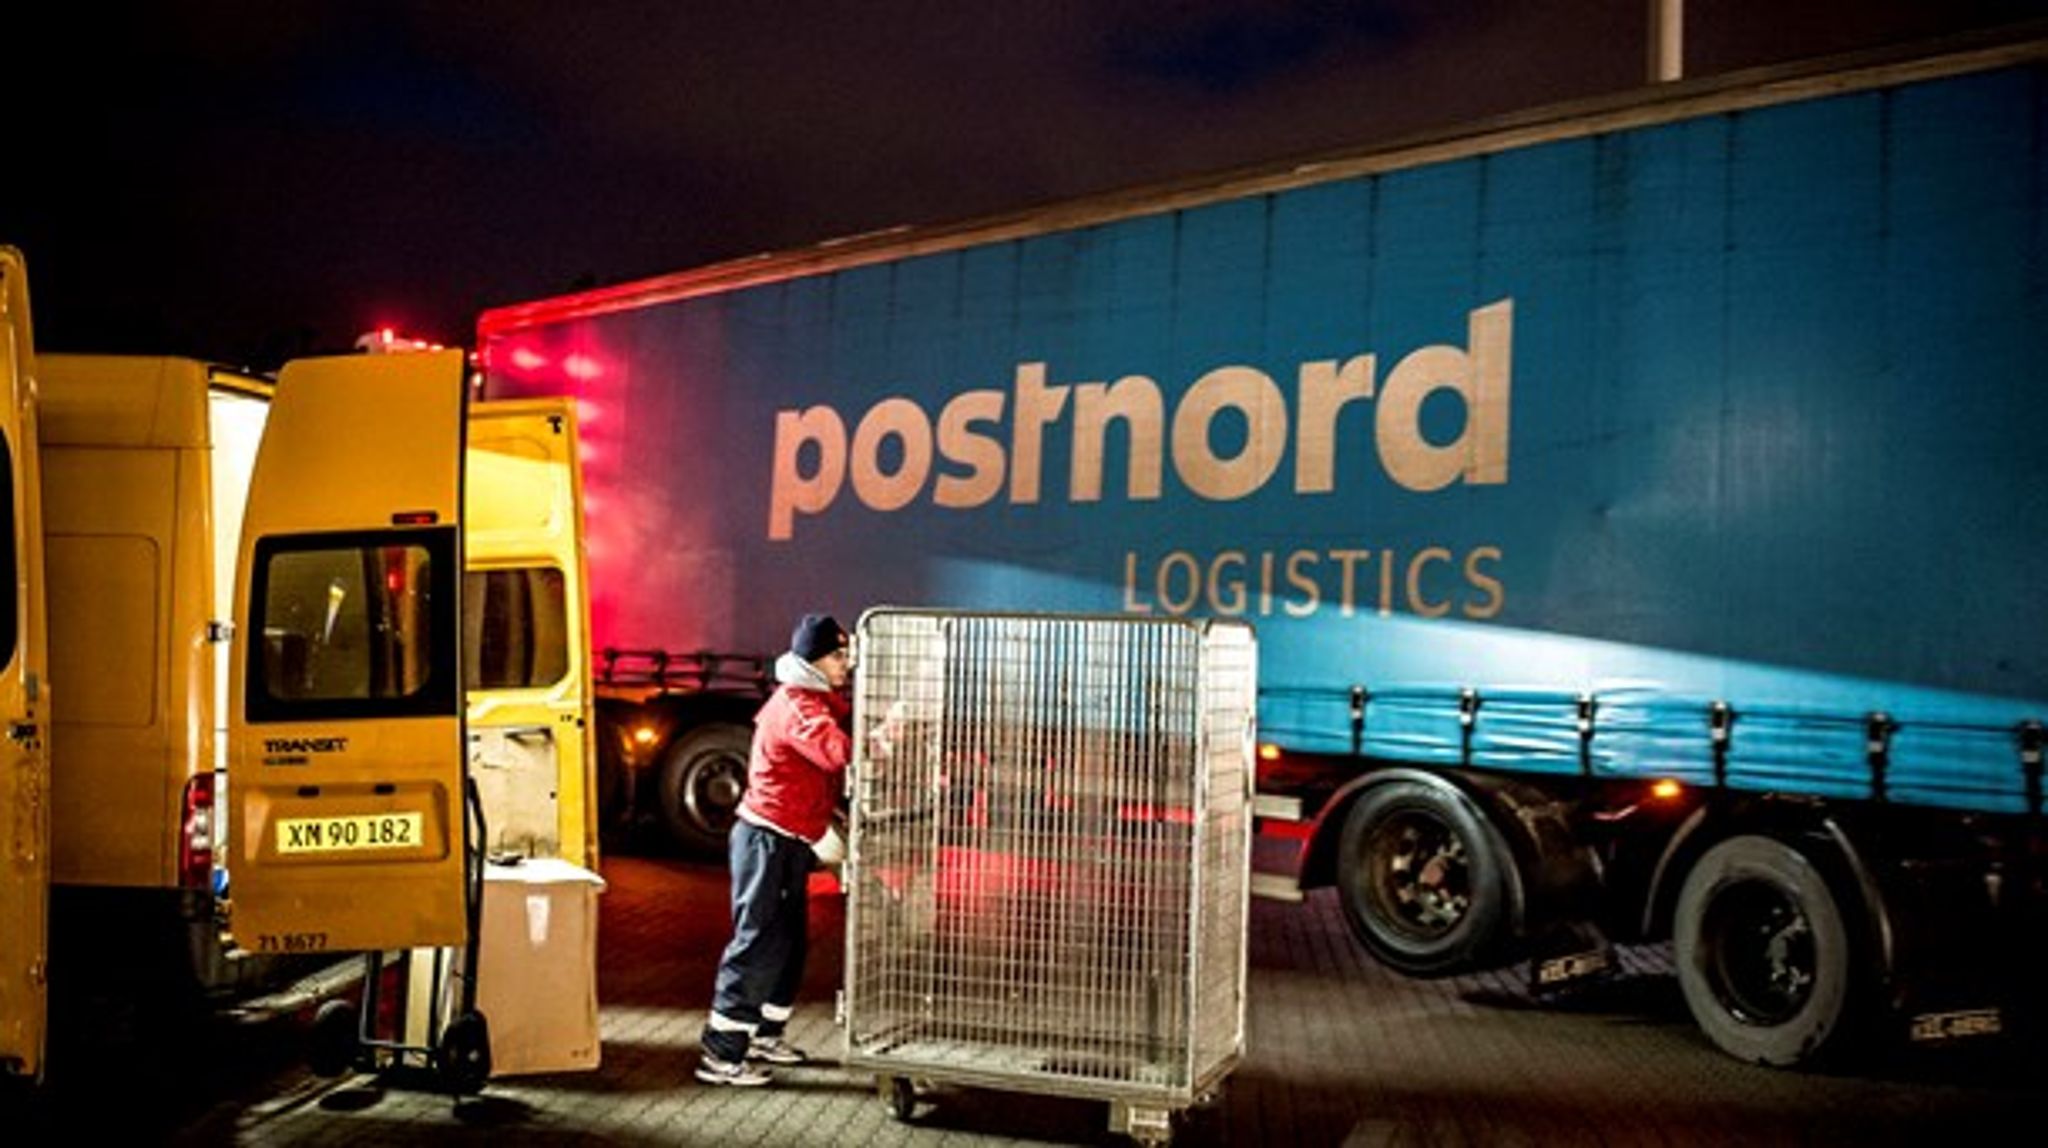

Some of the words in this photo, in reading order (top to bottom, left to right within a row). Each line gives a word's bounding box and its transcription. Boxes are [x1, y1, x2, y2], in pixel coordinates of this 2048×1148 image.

[768, 299, 1514, 541] postnord
[1124, 547, 1505, 618] LOGISTICS
[264, 738, 348, 752] TRANSIT
[288, 824, 323, 847] XM
[329, 821, 359, 846] 90
[368, 818, 411, 844] 182
